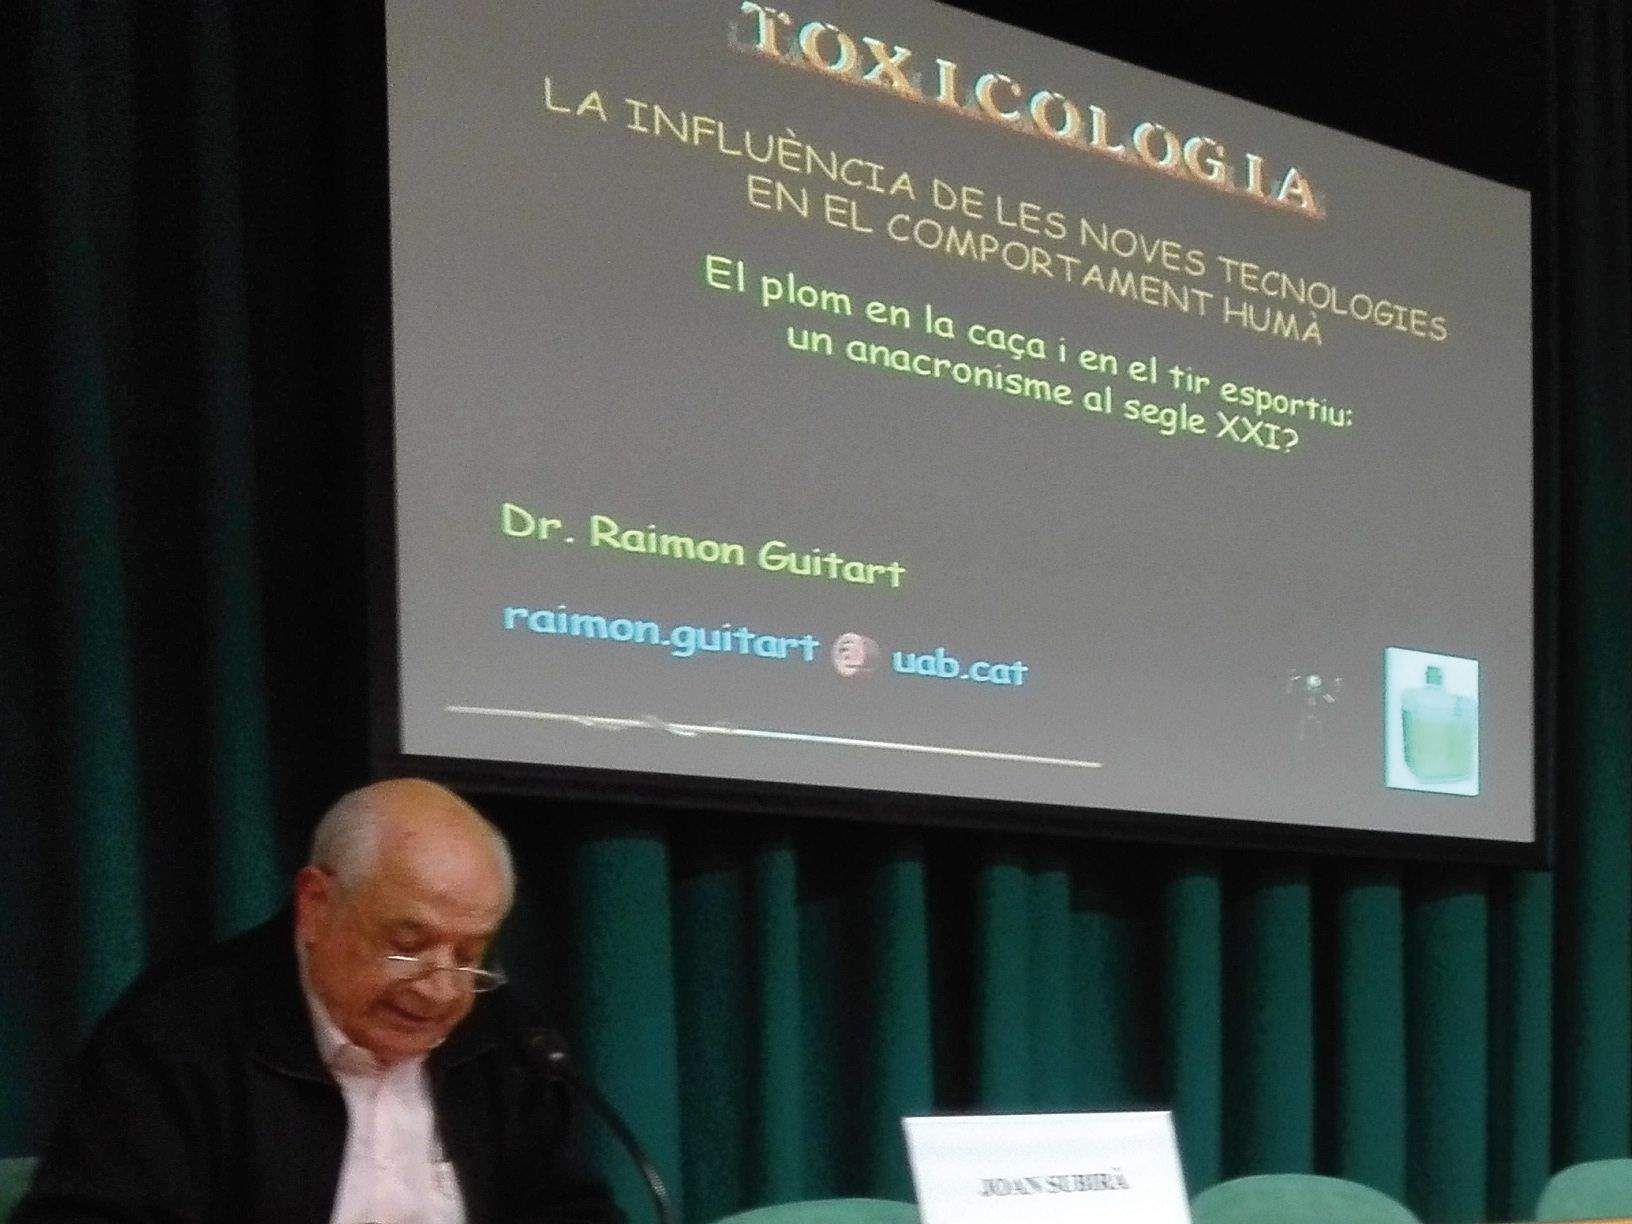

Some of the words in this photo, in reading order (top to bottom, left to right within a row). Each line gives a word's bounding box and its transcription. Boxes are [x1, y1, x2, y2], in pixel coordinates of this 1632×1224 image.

[741, 1, 1325, 219] TOXICOLOGIA
[544, 75, 607, 121] LA
[624, 98, 916, 201] INFLUÈNCIA
[932, 178, 984, 219] DE
[996, 194, 1067, 241] LES
[1080, 217, 1206, 278] NOVES
[1216, 256, 1449, 342] TECNOLOGIES
[747, 174, 809, 218] EN
[823, 194, 874, 234] EL
[887, 213, 1214, 317] COMPORTAMENT
[1222, 296, 1323, 347] HUMÀ
[705, 254, 744, 292] El
[761, 272, 852, 317] plom
[866, 299, 911, 329] en
[925, 303, 956, 340] la
[967, 322, 1046, 360] caça
[1058, 330, 1067, 363] i
[1079, 349, 1118, 377] en
[1129, 356, 1158, 384] el
[1168, 364, 1211, 396] tir
[1219, 381, 1354, 428] esportiu:
[786, 324, 833, 357] un
[846, 338, 1073, 408] anacronisme
[1081, 382, 1112, 415] al
[1122, 395, 1206, 437] segle
[1216, 410, 1300, 455] XXI?
[500, 502, 576, 544] Dr.
[590, 513, 745, 568] Raimon
[757, 540, 907, 588] Guitart
[503, 604, 821, 663] raimon.guitart
[892, 647, 1030, 688] uab.cat
